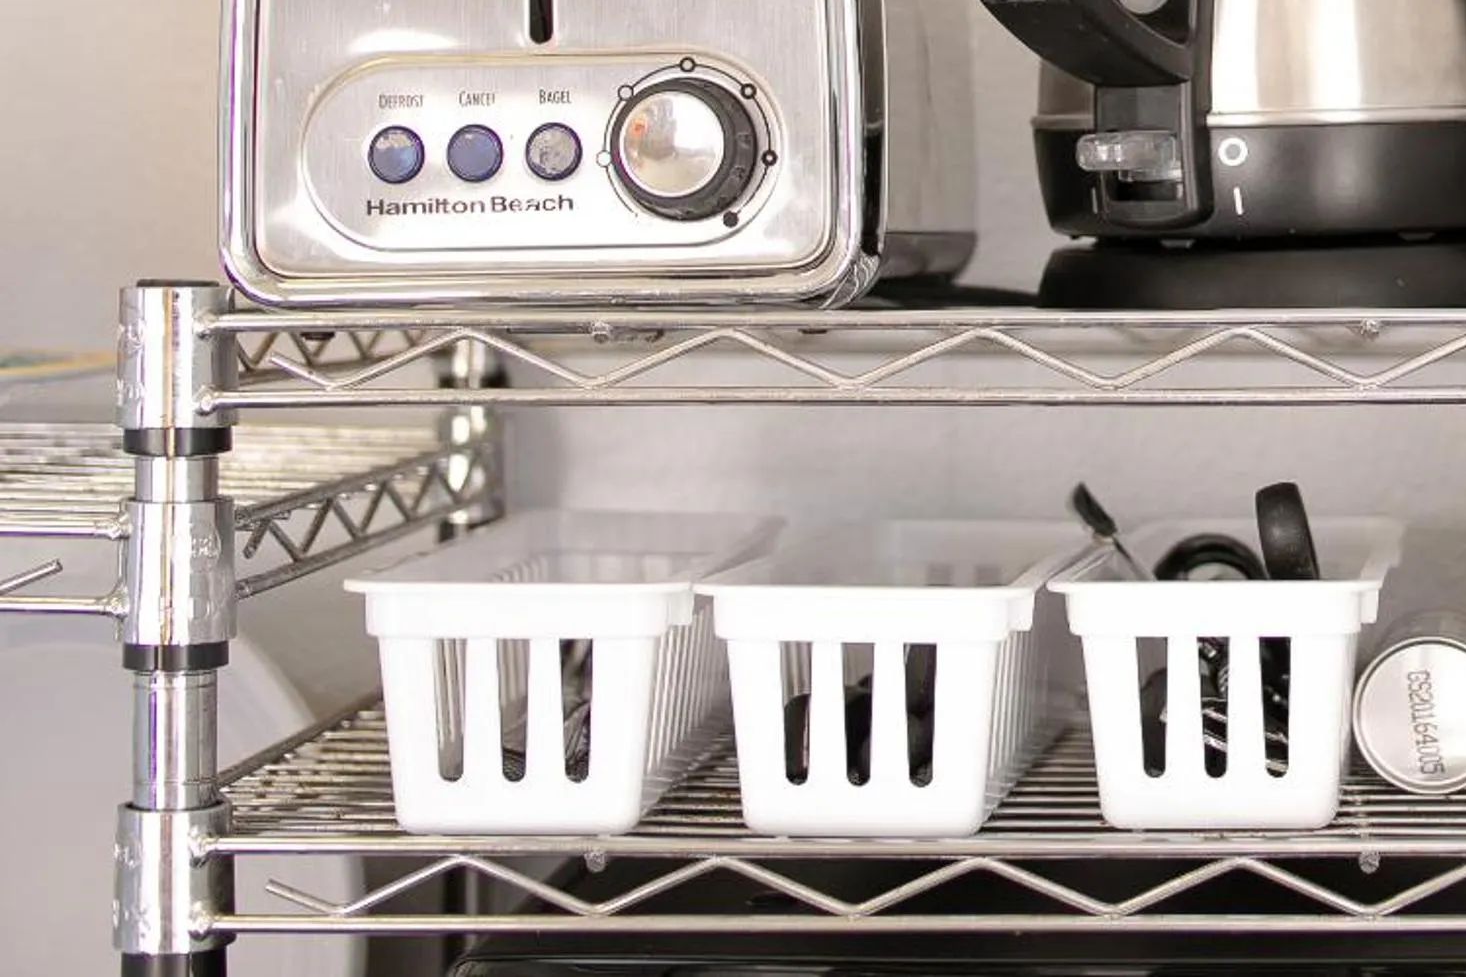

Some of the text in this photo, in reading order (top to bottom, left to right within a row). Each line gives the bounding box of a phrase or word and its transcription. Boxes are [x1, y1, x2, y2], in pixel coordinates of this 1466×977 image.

[539, 89, 572, 105] BAGEL
[366, 194, 574, 216] Hamilton Beach
